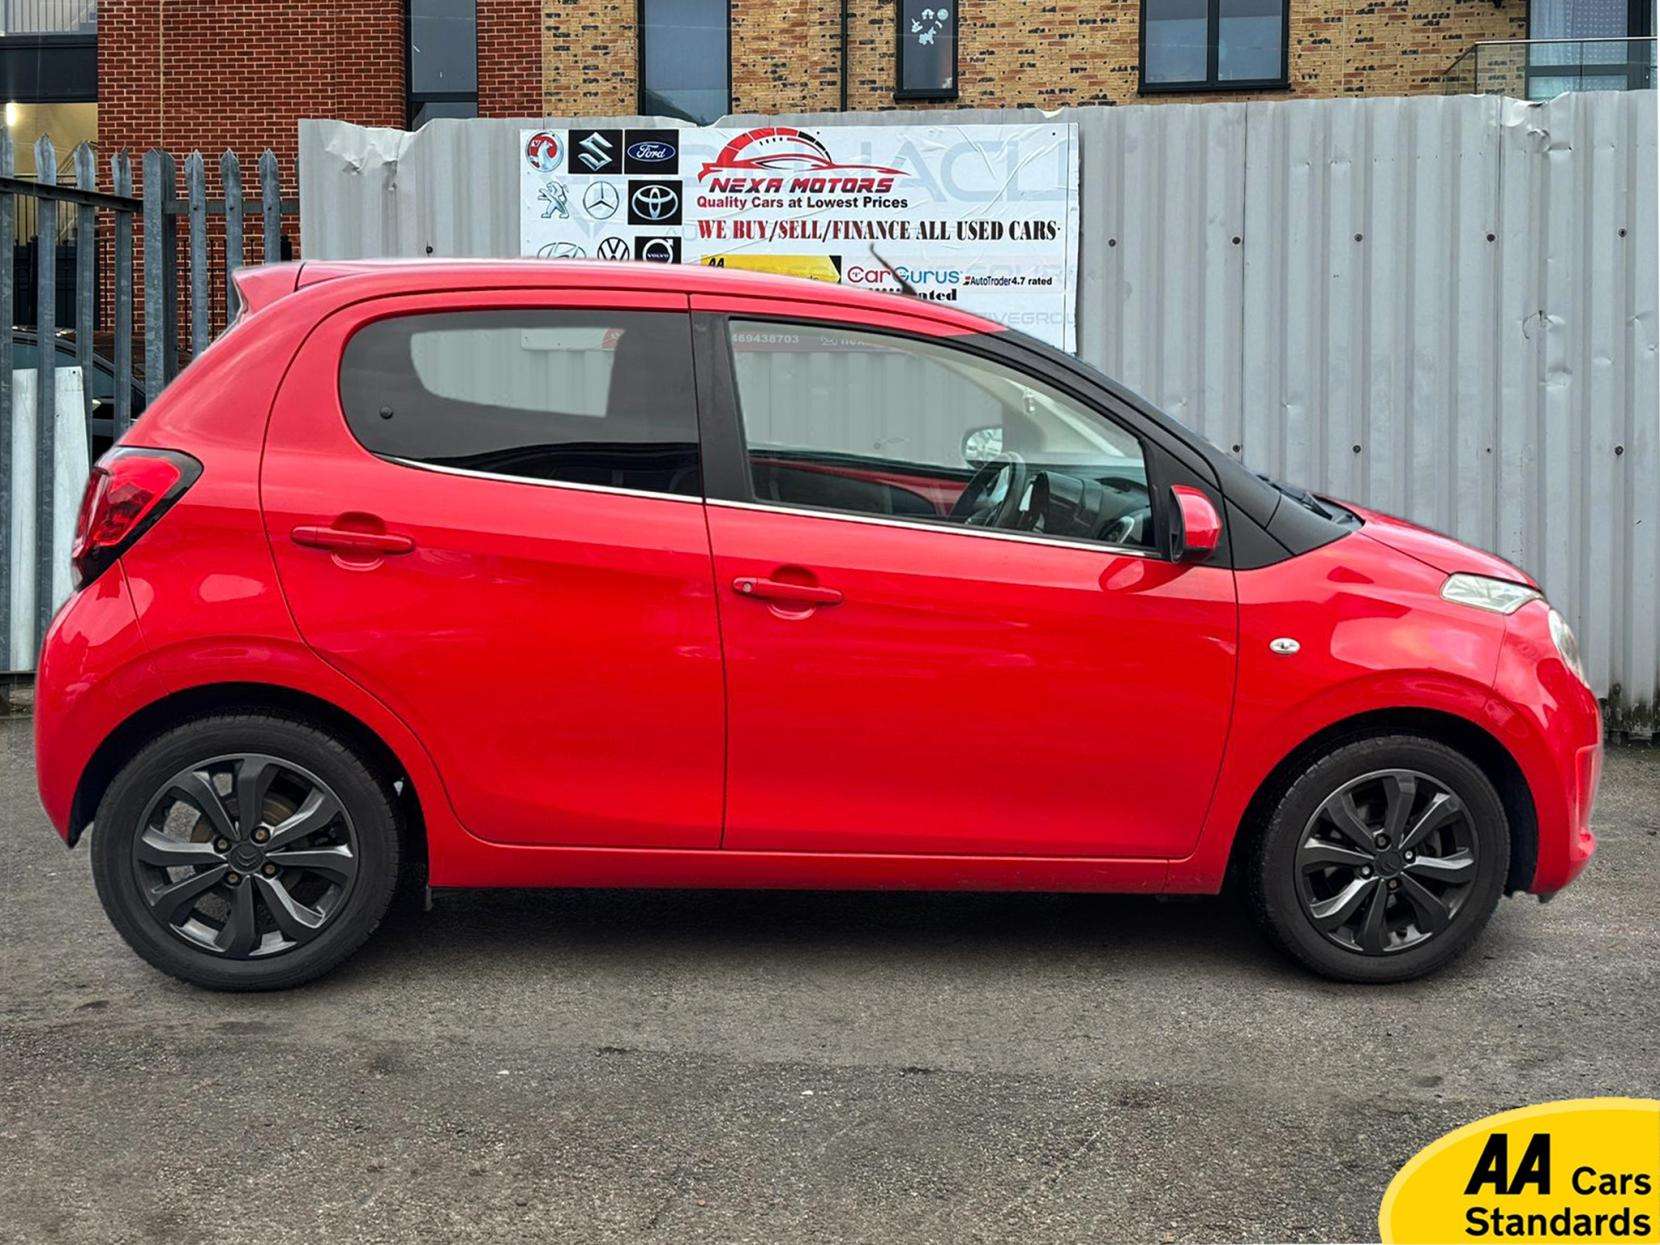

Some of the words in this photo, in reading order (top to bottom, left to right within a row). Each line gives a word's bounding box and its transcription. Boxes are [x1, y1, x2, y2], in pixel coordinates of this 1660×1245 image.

[636, 144, 666, 159] Ford
[709, 177, 784, 193] NEXA
[789, 177, 894, 193] MOTORS
[697, 196, 750, 210] Quality
[752, 196, 784, 209] Cars
[788, 196, 803, 209] at
[807, 196, 859, 209] Lowest
[863, 196, 908, 209] Prices
[697, 219, 726, 240] WE
[916, 219, 951, 240] ALL
[957, 219, 1002, 240] USED
[1008, 219, 1057, 240] CARS
[847, 266, 960, 284] CarGurus
[1027, 276, 1053, 286] rated
[918, 288, 958, 301] ated
